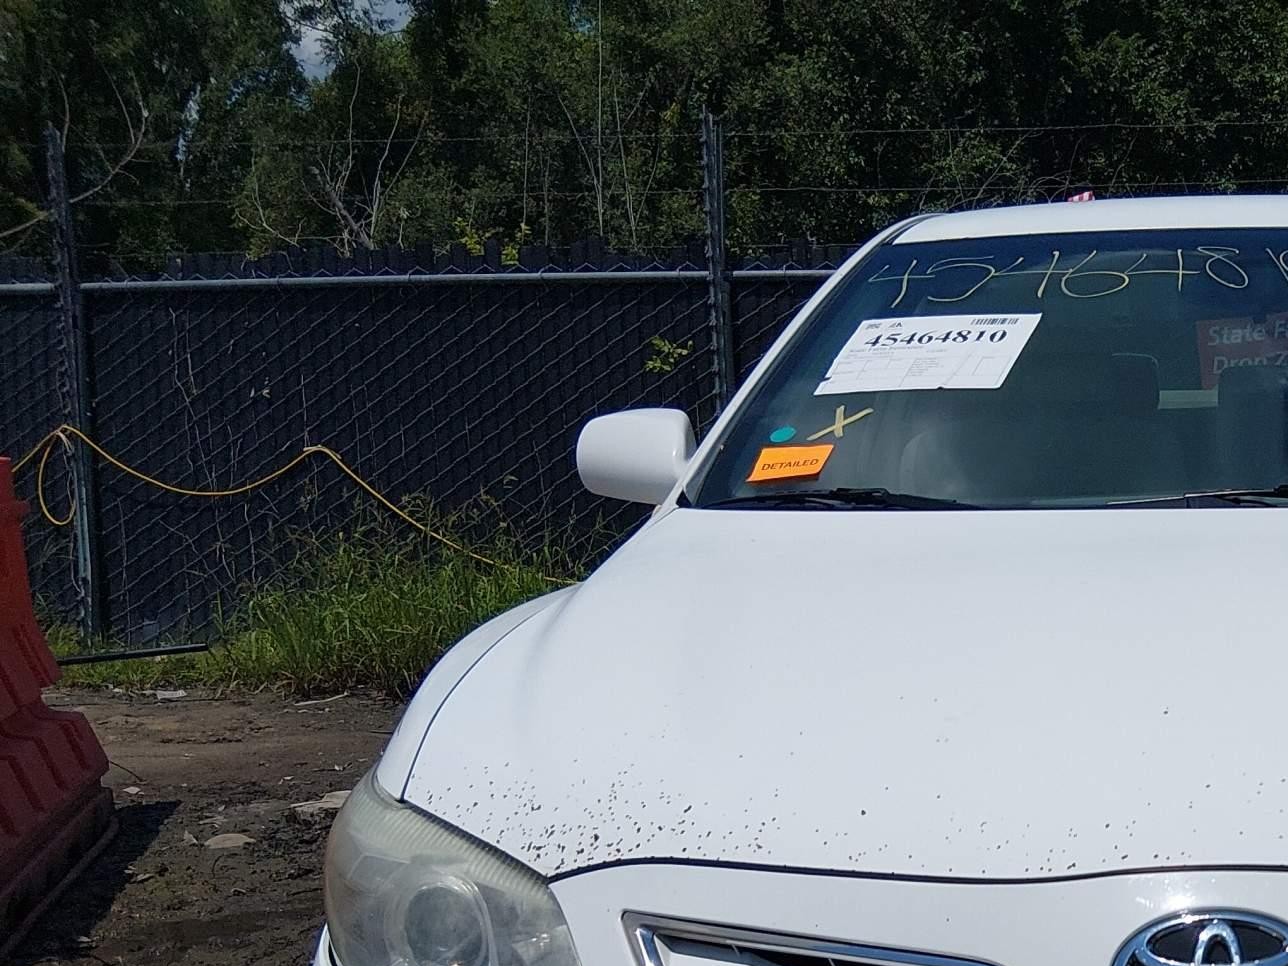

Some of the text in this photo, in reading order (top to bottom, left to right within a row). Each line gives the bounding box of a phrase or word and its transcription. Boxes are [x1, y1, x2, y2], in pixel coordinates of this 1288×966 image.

[864, 329, 1007, 347] 45464810
[1208, 322, 1266, 346] State
[761, 458, 819, 471] DETAILED
